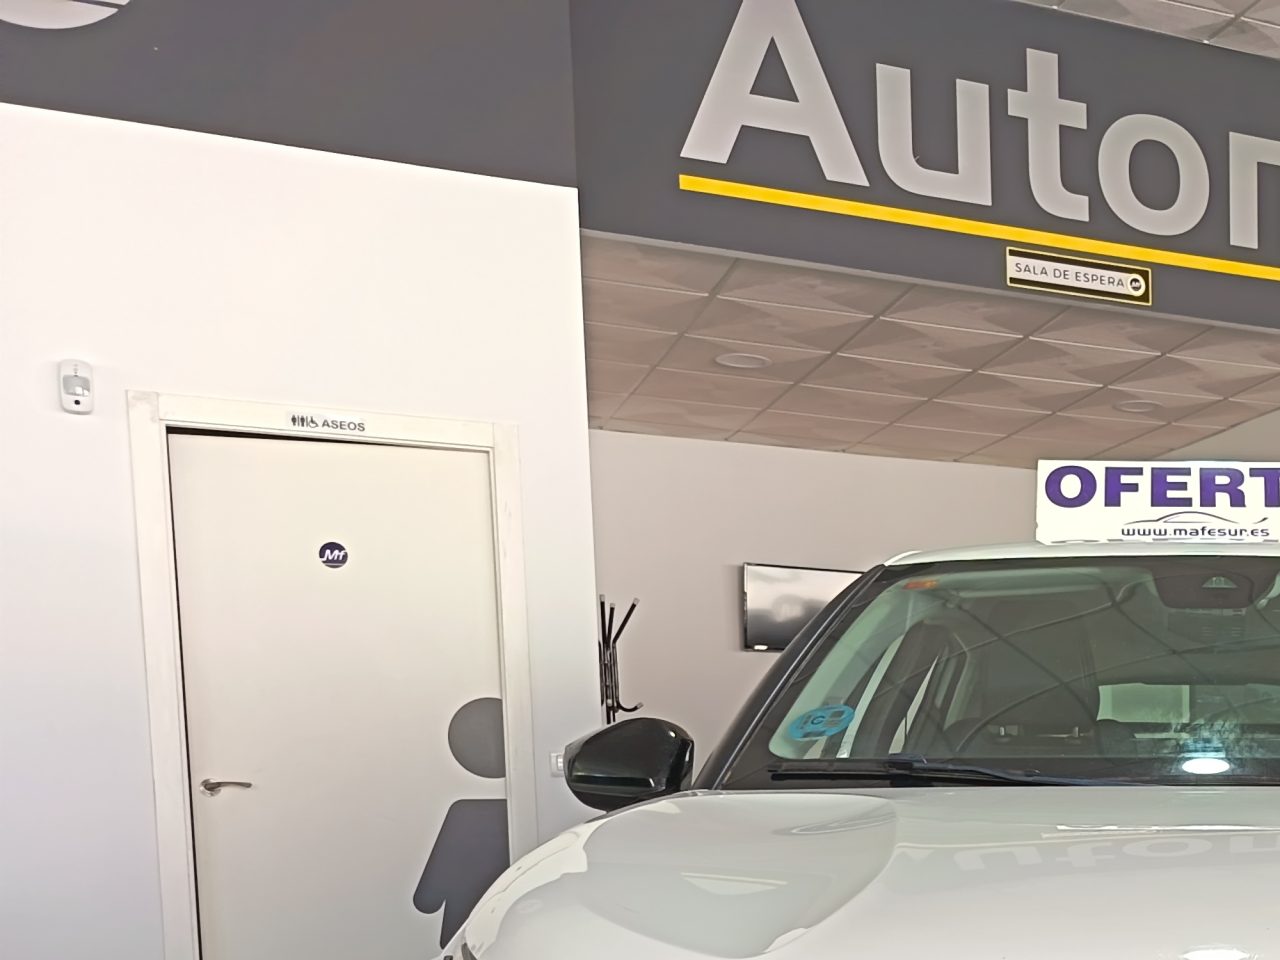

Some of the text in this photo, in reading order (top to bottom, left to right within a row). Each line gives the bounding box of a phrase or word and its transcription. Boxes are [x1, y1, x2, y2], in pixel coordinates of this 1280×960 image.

[1015, 262, 1049, 277] SALA
[1053, 268, 1070, 280] DE
[1075, 271, 1125, 288] ESPERA
[321, 419, 366, 432] ASEOS
[1121, 526, 1270, 538] www.mafesur.es
